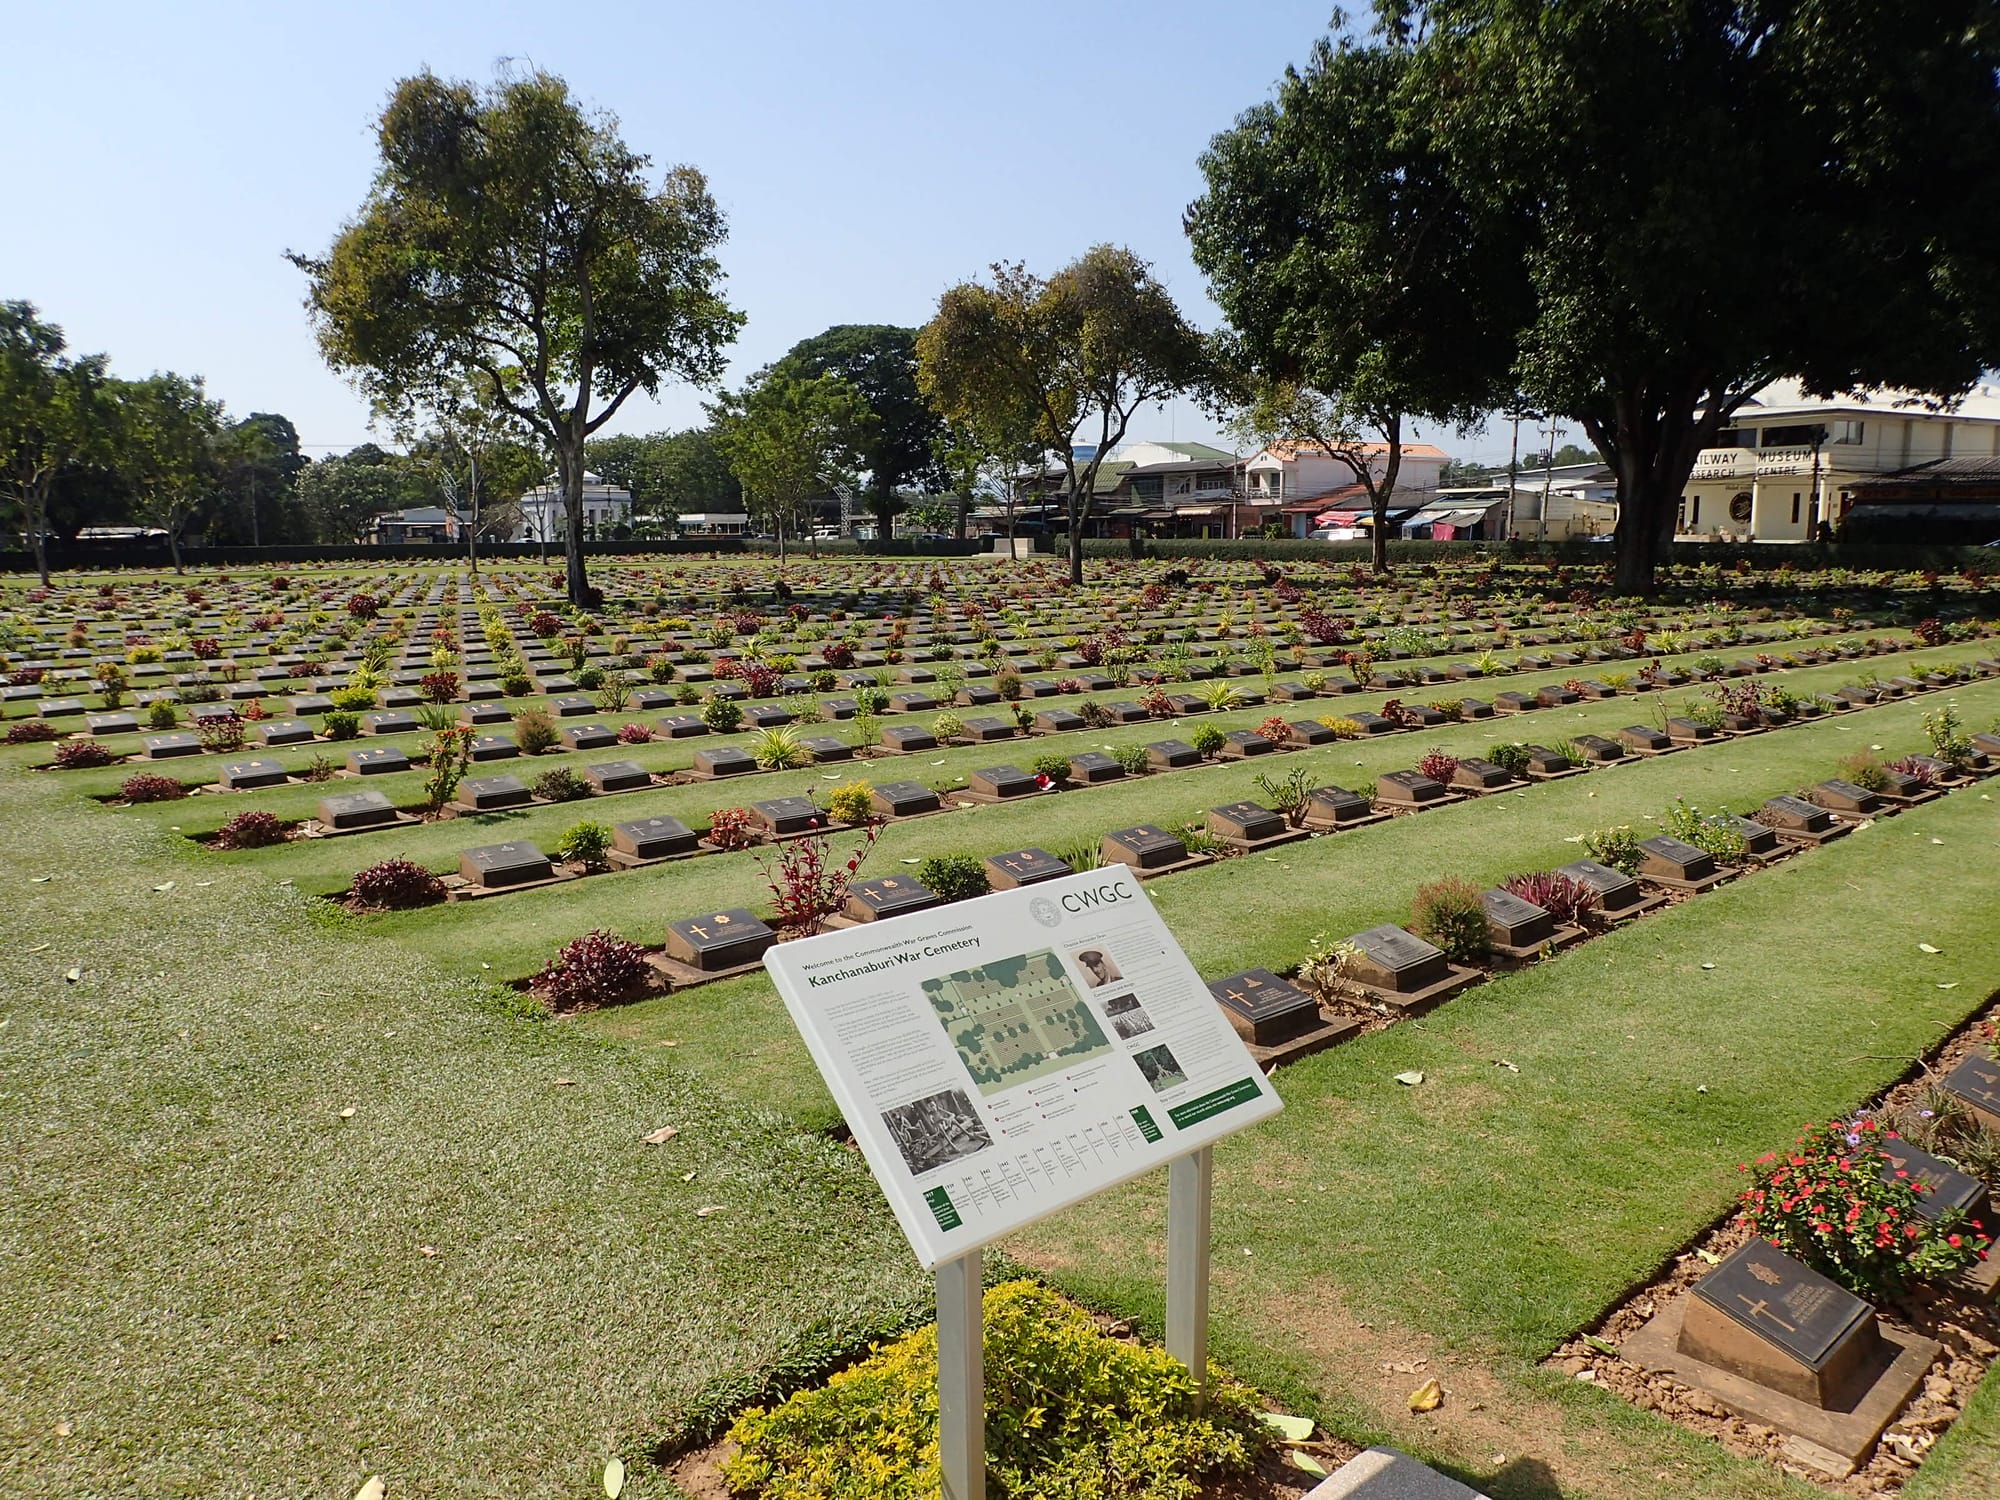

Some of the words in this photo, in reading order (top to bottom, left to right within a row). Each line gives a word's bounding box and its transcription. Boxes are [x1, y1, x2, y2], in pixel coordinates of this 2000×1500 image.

[1696, 453, 1737, 465] ILWAY
[1758, 450, 1812, 462] MUSEUM
[1757, 466, 1798, 476] CENTRE
[1061, 882, 1133, 912] CWGC
[802, 959, 835, 971] Welcome
[843, 954, 854, 963] the
[855, 942, 902, 958] Commonwealth
[902, 938, 917, 946] War
[917, 933, 938, 942] Graves
[938, 924, 973, 937] Commission
[808, 956, 896, 988] Kanchanaburi
[893, 951, 921, 965] War
[923, 936, 981, 957] Cemetery
